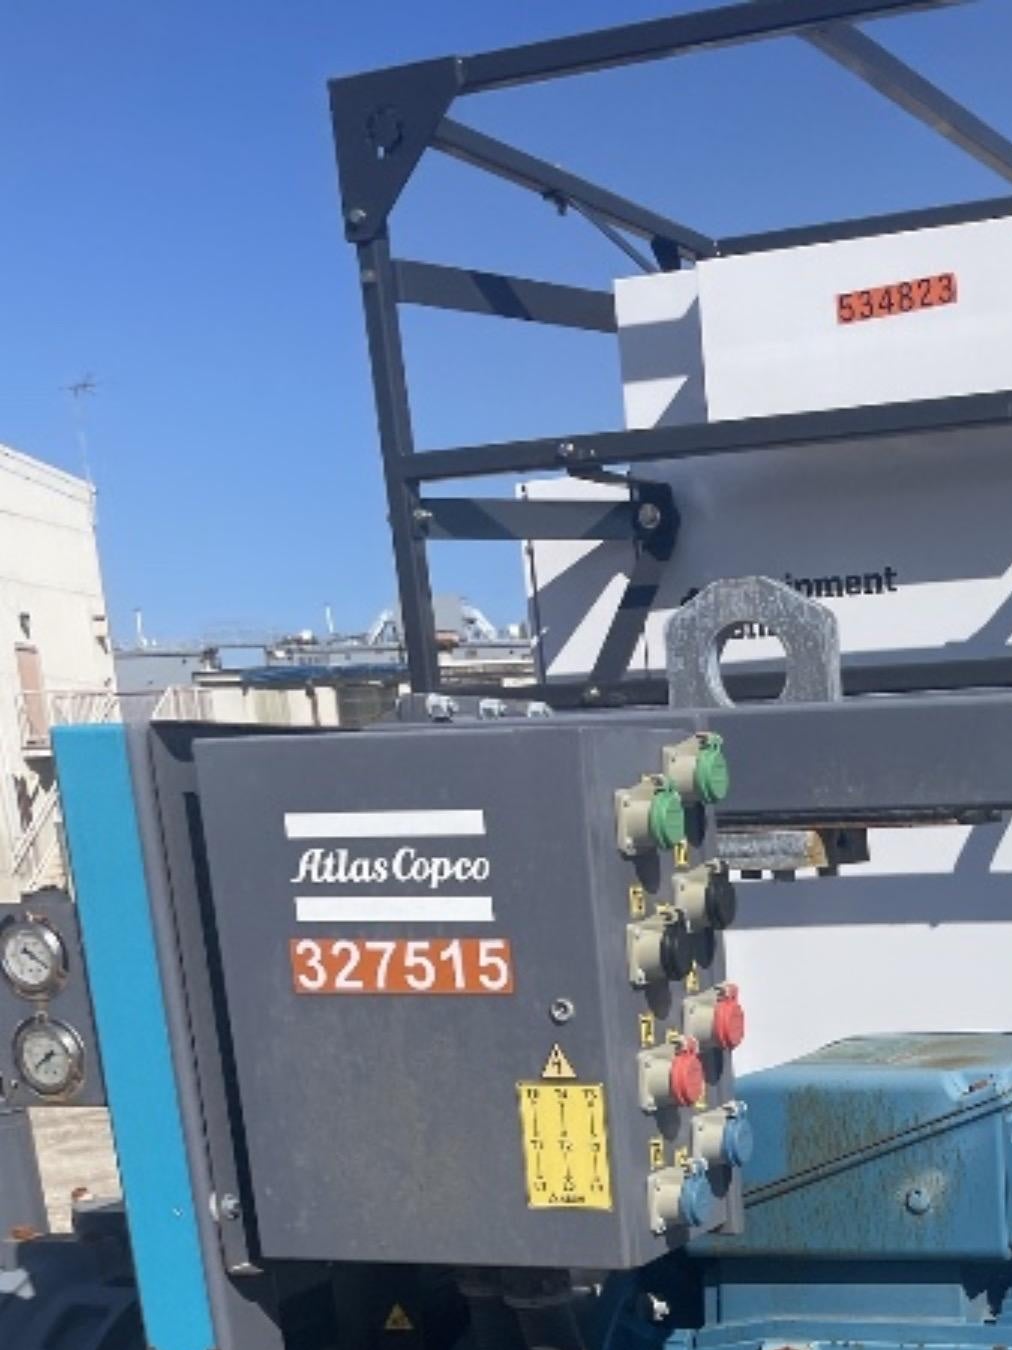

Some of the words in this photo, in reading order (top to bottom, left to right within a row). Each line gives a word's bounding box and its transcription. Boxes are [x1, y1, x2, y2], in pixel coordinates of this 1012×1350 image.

[838, 274, 953, 322] 534823
[290, 848, 389, 884] Atlas
[391, 846, 490, 889] Copco
[295, 938, 509, 991] 327515
